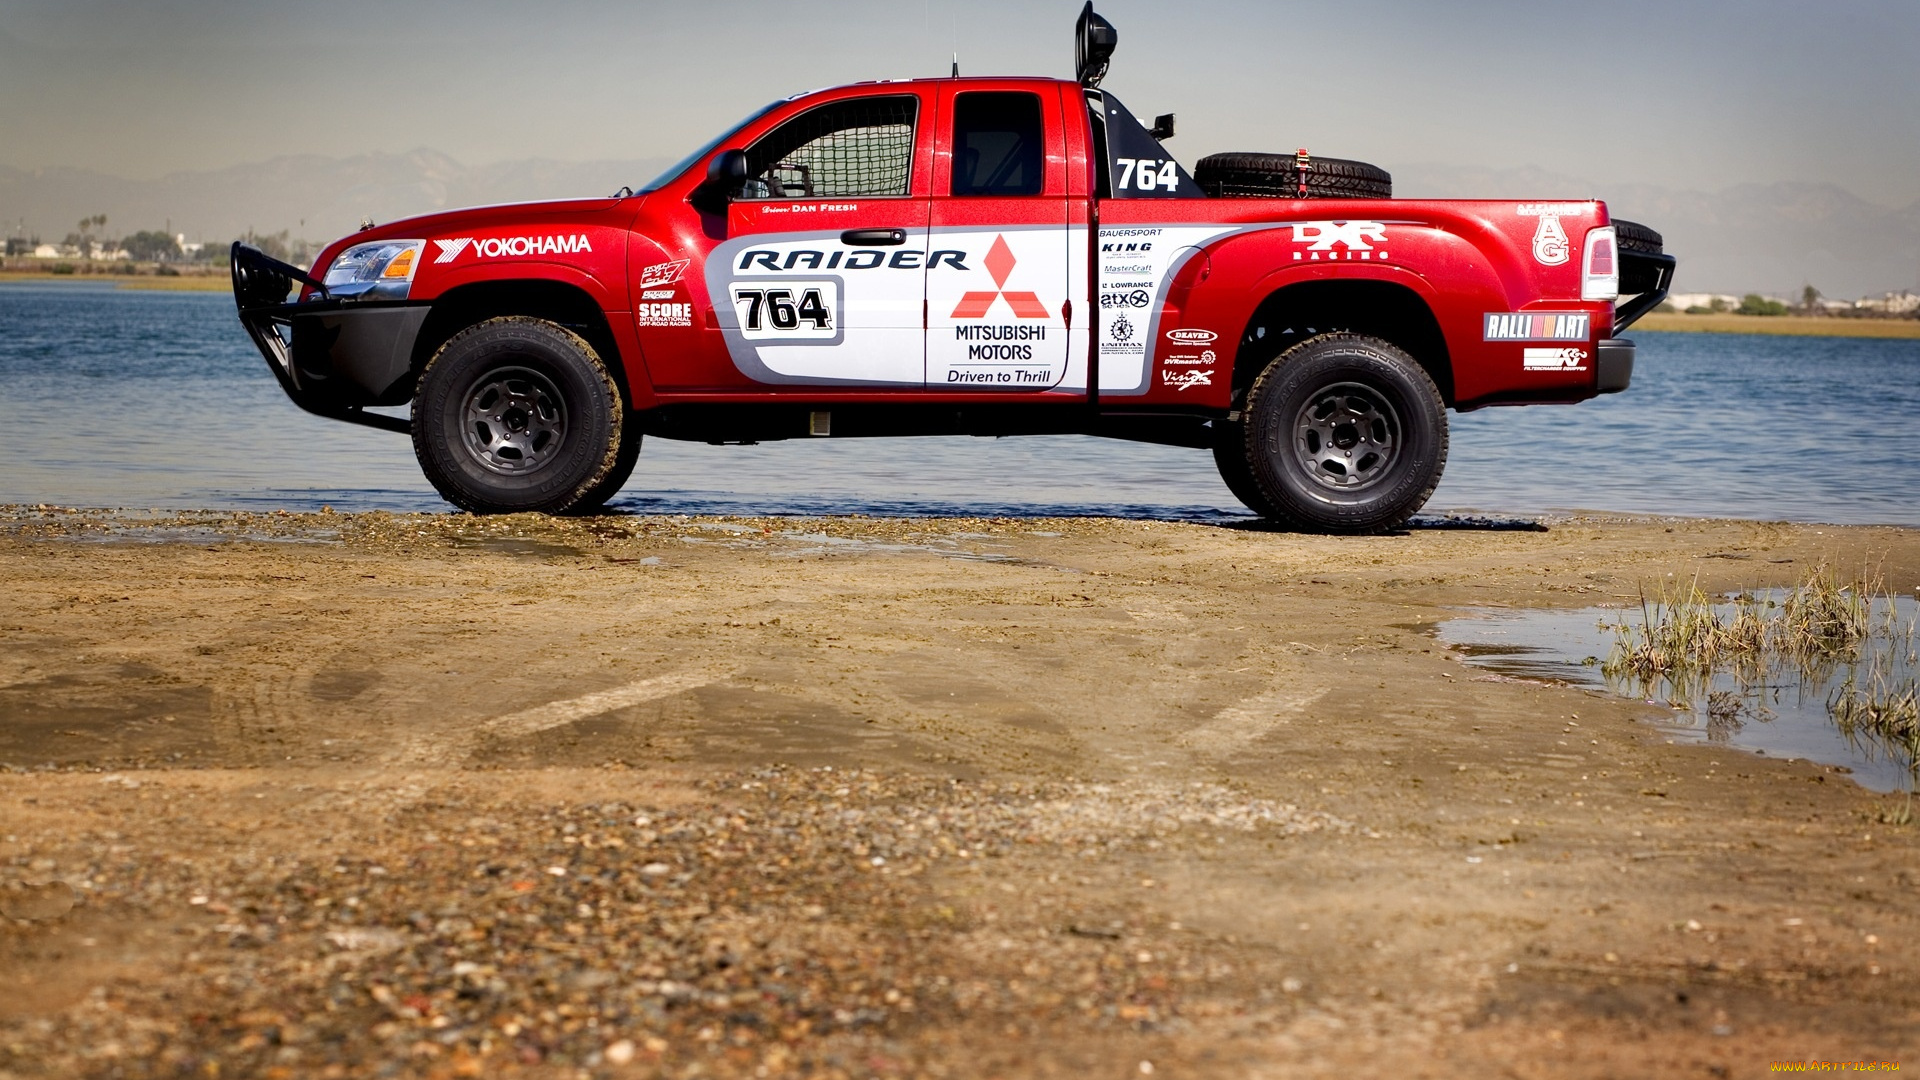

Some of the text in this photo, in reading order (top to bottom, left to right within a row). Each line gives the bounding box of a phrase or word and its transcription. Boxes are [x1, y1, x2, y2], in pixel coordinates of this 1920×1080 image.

[1116, 158, 1179, 192] 764
[792, 205, 817, 213] DAN
[820, 204, 857, 212] FRESH
[1099, 229, 1163, 237] BAUERSPORT
[472, 234, 592, 258] YOKOHAMA
[1102, 242, 1152, 252] KING
[738, 250, 971, 271] RAIDER
[1292, 251, 1389, 260] RACING
[639, 303, 691, 317] SCORE
[735, 288, 833, 331] 764
[956, 325, 1046, 341] MITSUBISHI
[1487, 315, 1588, 338] RALLI ART
[968, 344, 1033, 361] MOTORS
[946, 370, 1051, 383] Driven to Thrill
